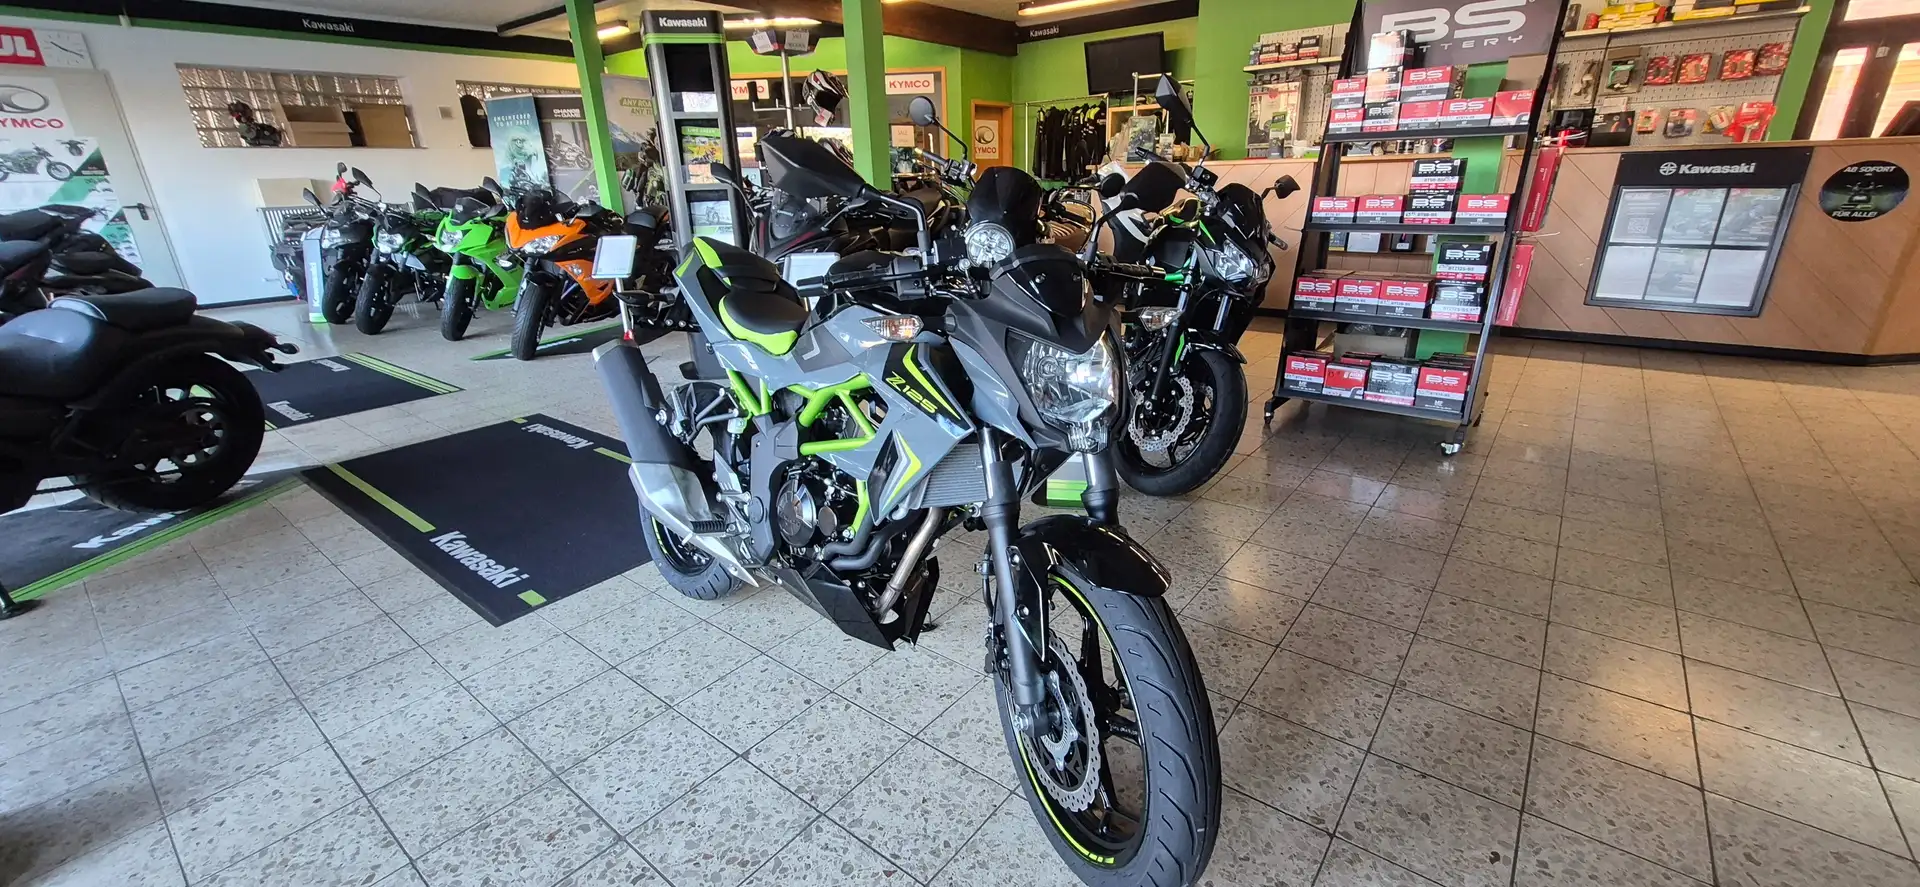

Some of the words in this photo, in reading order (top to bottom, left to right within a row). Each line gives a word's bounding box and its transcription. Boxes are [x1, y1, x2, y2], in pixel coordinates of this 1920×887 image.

[301, 18, 355, 33] Kawasaki
[659, 17, 708, 28] Kawasaki
[1380, 0, 1526, 43] BS
[1029, 25, 1060, 38] Kawasaki
[1418, 35, 1524, 53] TTERY
[1409, 70, 1444, 81] BS
[889, 80, 931, 89] KYMCO
[1449, 101, 1484, 111] BS
[1419, 163, 1453, 171] BS
[1678, 163, 1757, 175] Kawasaki
[1319, 200, 1349, 208] BS
[1366, 199, 1396, 207] BS
[1412, 198, 1446, 207] BS
[1468, 199, 1499, 207] BS
[1446, 249, 1482, 258] BS
[1298, 281, 1331, 291] BS
[1343, 284, 1374, 293] BS
[1387, 286, 1420, 295] BS
[1440, 291, 1476, 300] BS
[1291, 361, 1320, 370] BS
[1372, 369, 1413, 383] BS
[1426, 374, 1460, 385] BS
[521, 423, 595, 450] Kawasaki
[429, 530, 530, 588] Kawasaki
